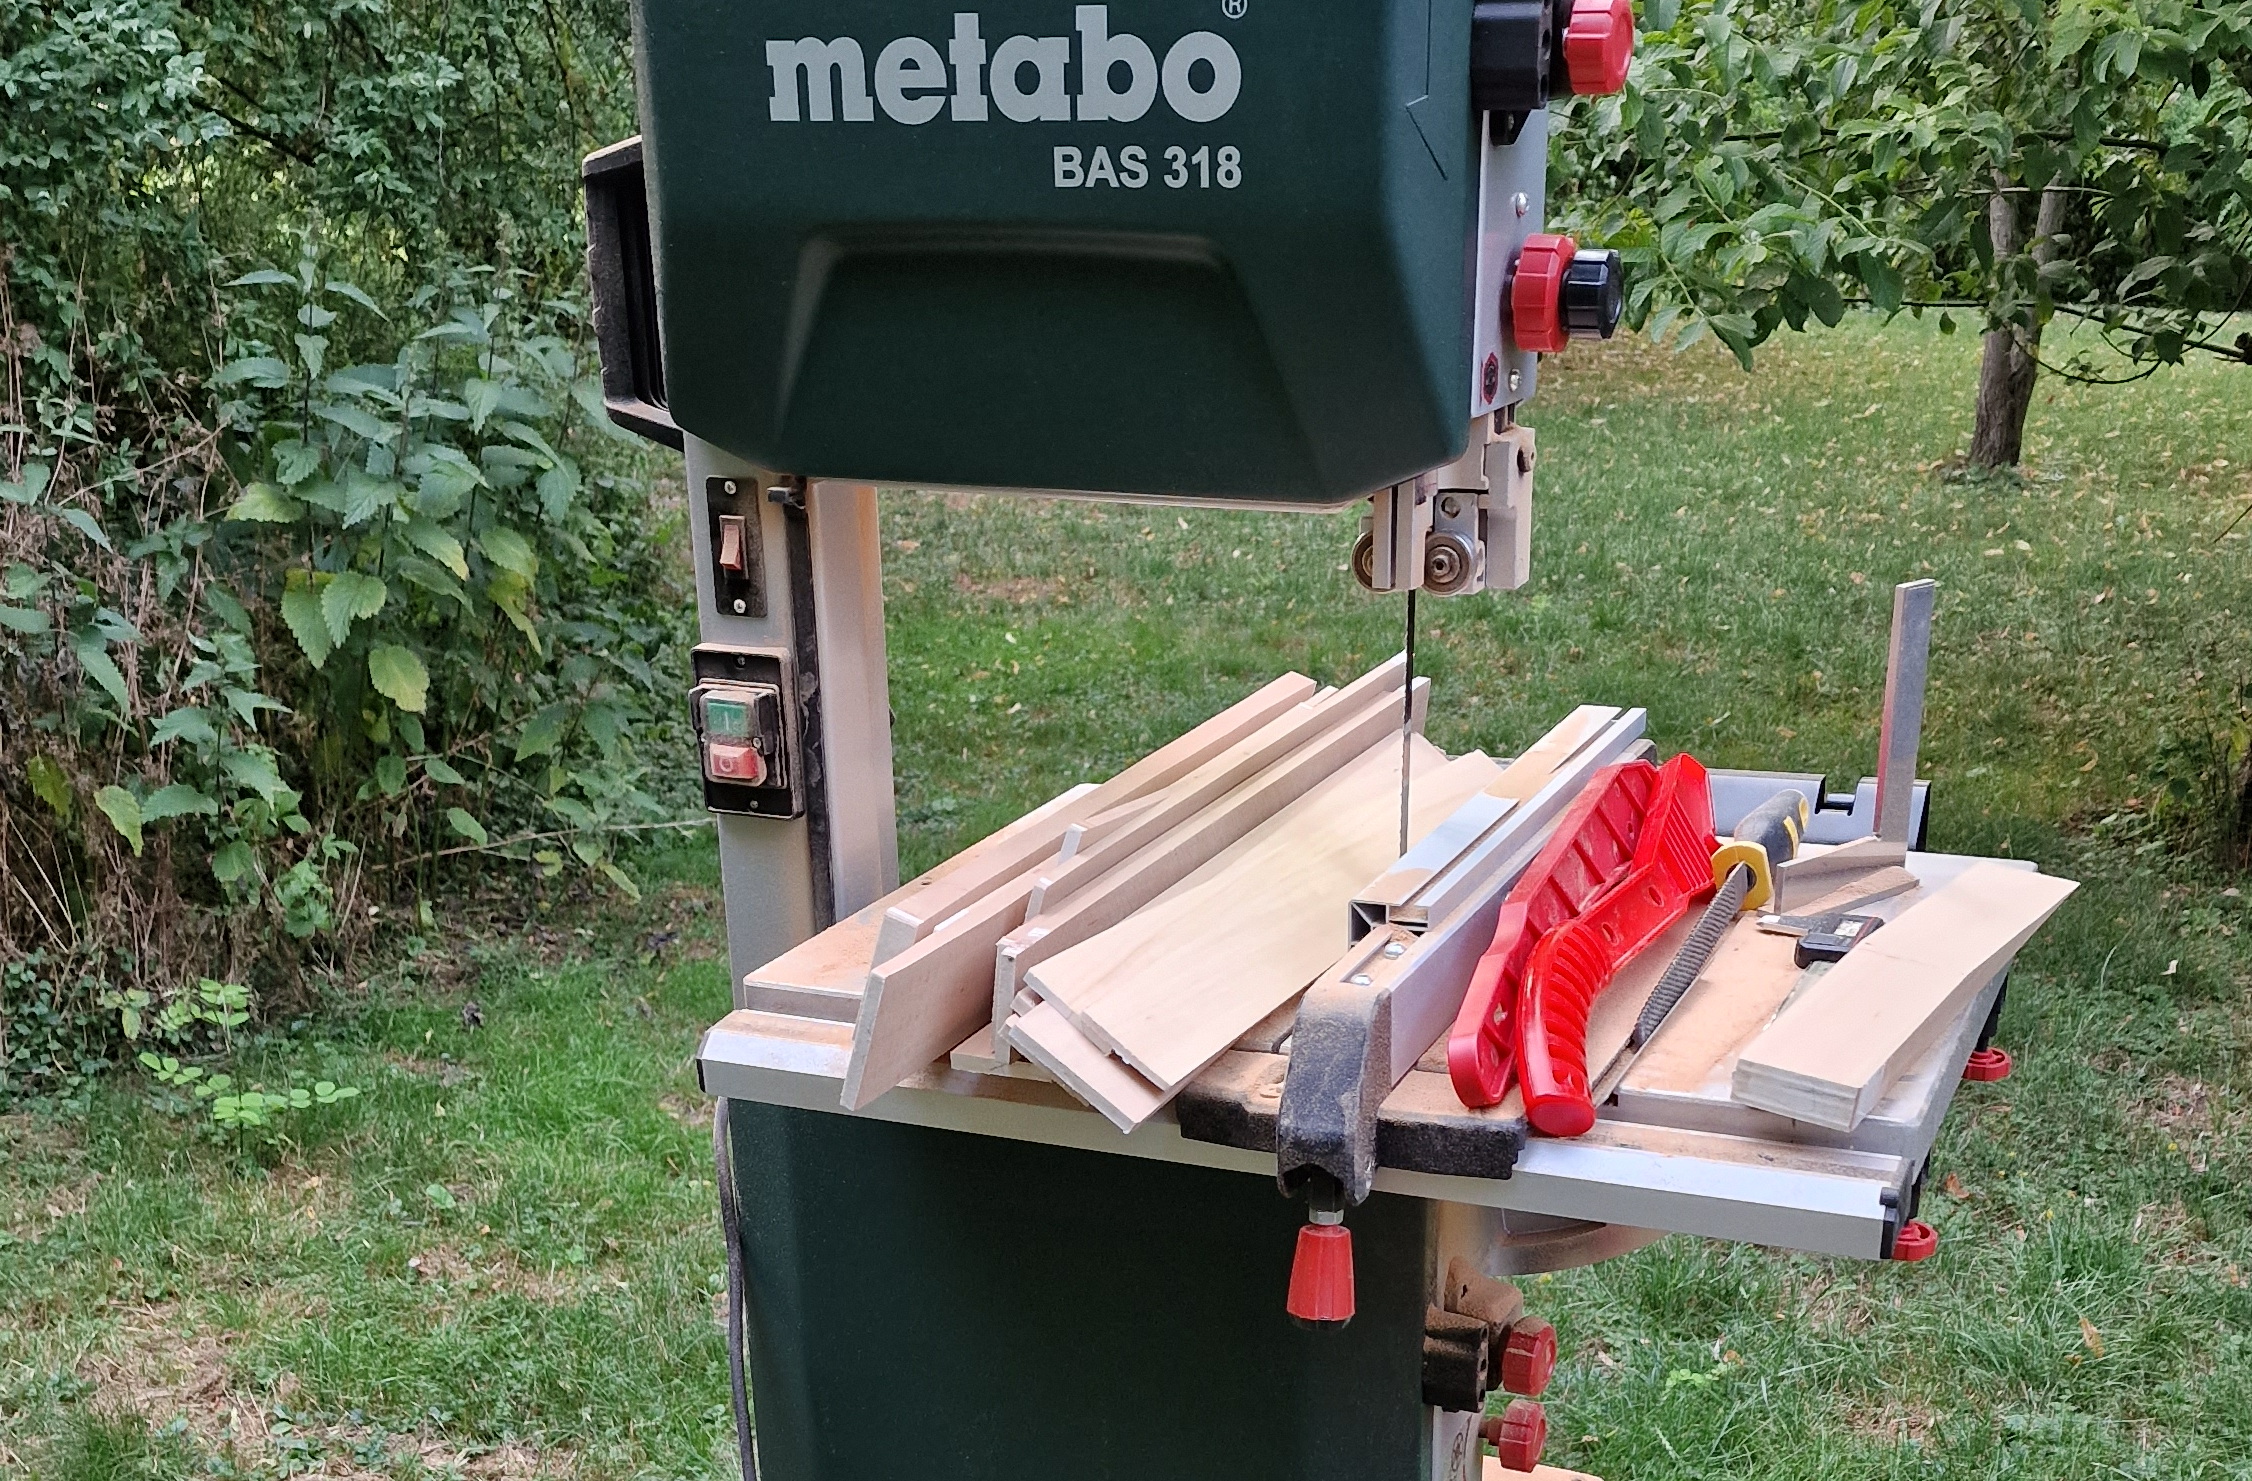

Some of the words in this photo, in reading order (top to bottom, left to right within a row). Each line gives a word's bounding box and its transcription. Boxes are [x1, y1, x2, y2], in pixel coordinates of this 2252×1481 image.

[766, 5, 1242, 125] metabo
[1053, 145, 1149, 189] BAS
[1163, 145, 1242, 189] 318
